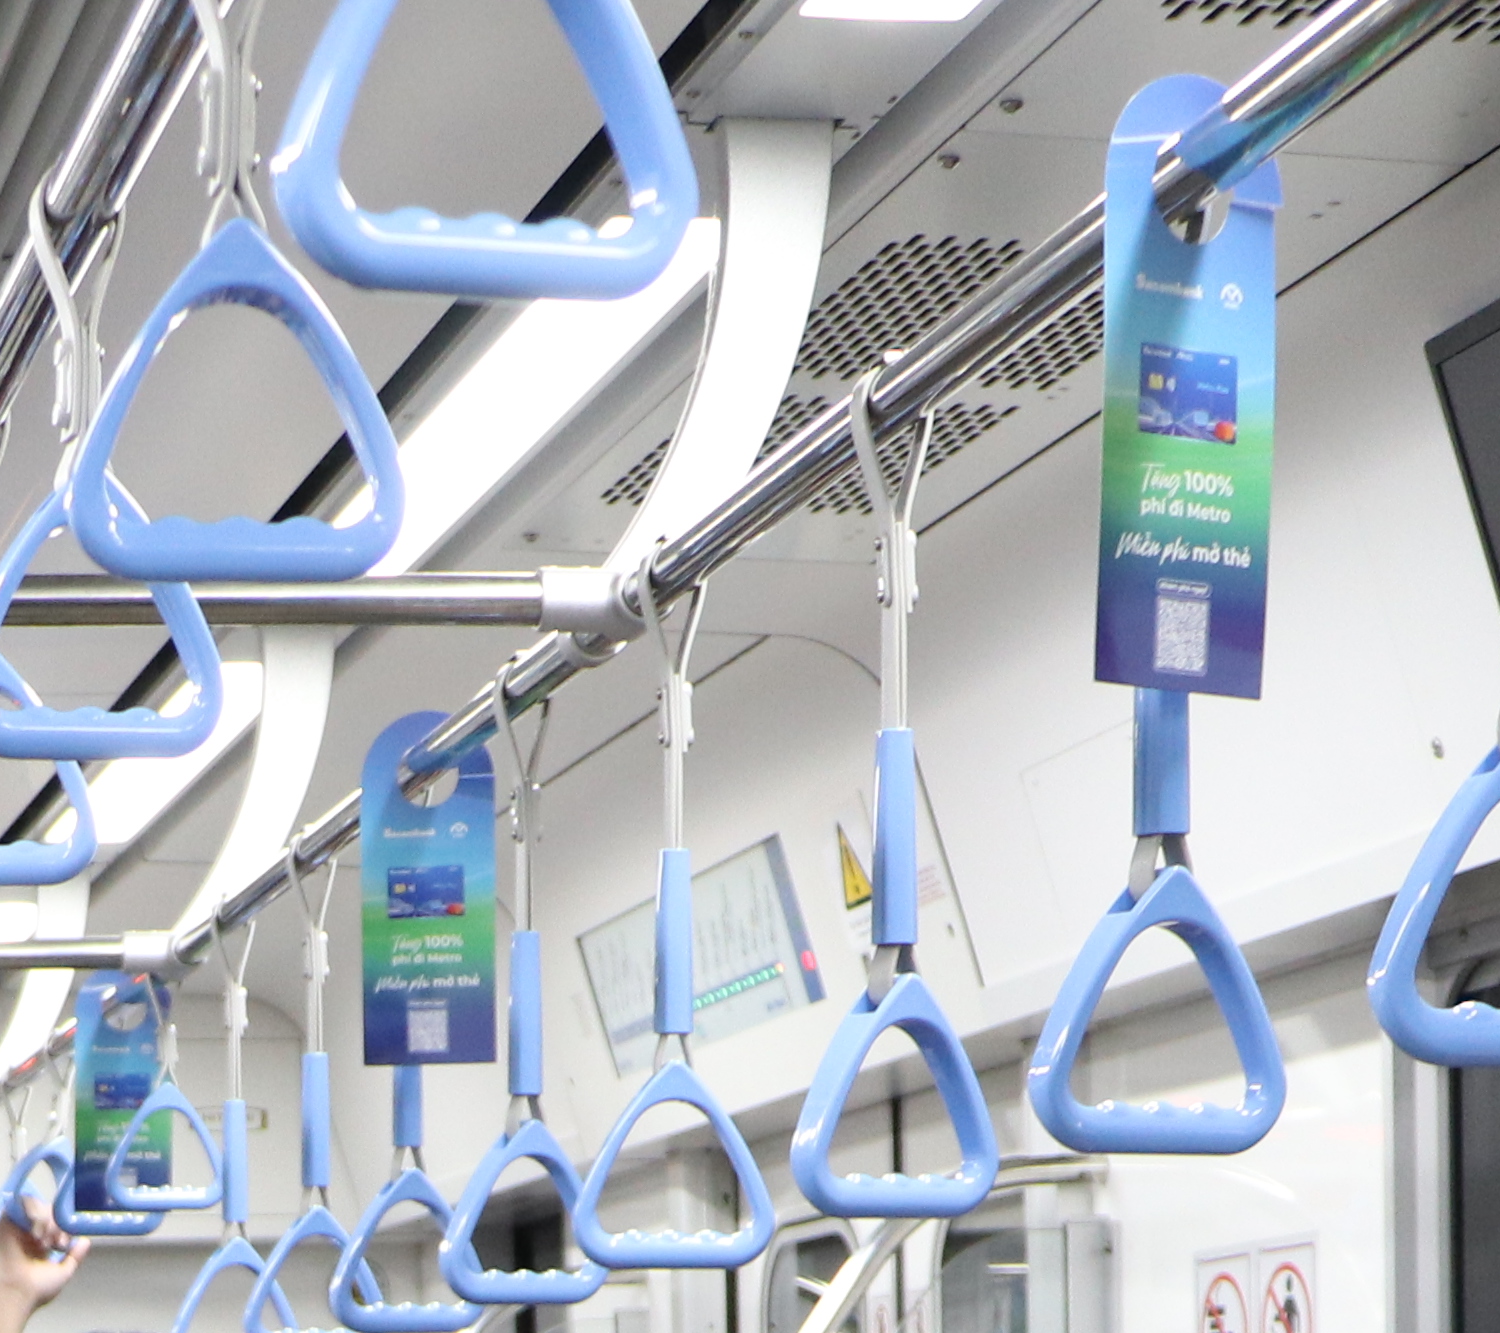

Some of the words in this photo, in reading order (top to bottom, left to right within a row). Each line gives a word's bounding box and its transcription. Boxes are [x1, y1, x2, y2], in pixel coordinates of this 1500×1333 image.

[1184, 470, 1234, 497] 100%
[1187, 502, 1231, 524] Metro
[424, 933, 464, 949] 100%
